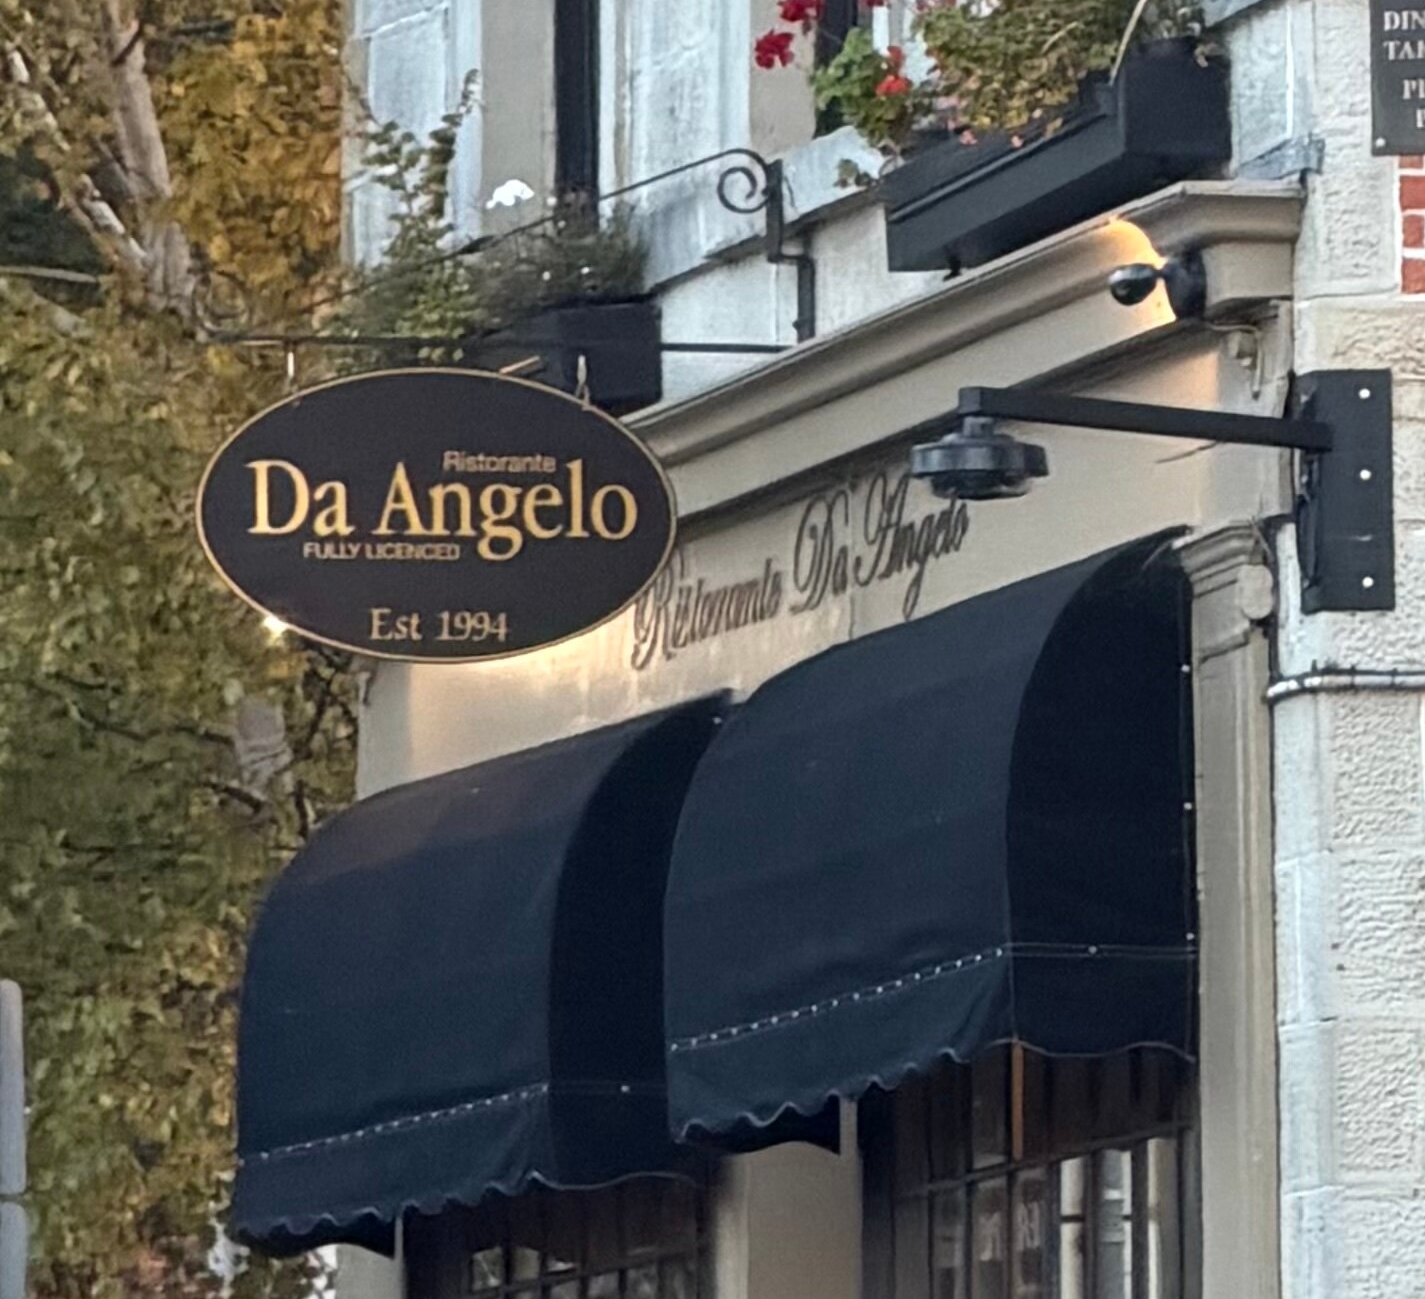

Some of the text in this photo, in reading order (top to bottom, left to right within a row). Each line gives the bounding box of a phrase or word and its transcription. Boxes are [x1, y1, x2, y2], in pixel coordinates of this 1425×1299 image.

[442, 450, 558, 474] Ristorante
[244, 458, 639, 561] Da Angelo
[303, 541, 362, 560] FULLY
[369, 607, 508, 643] Est 1994
